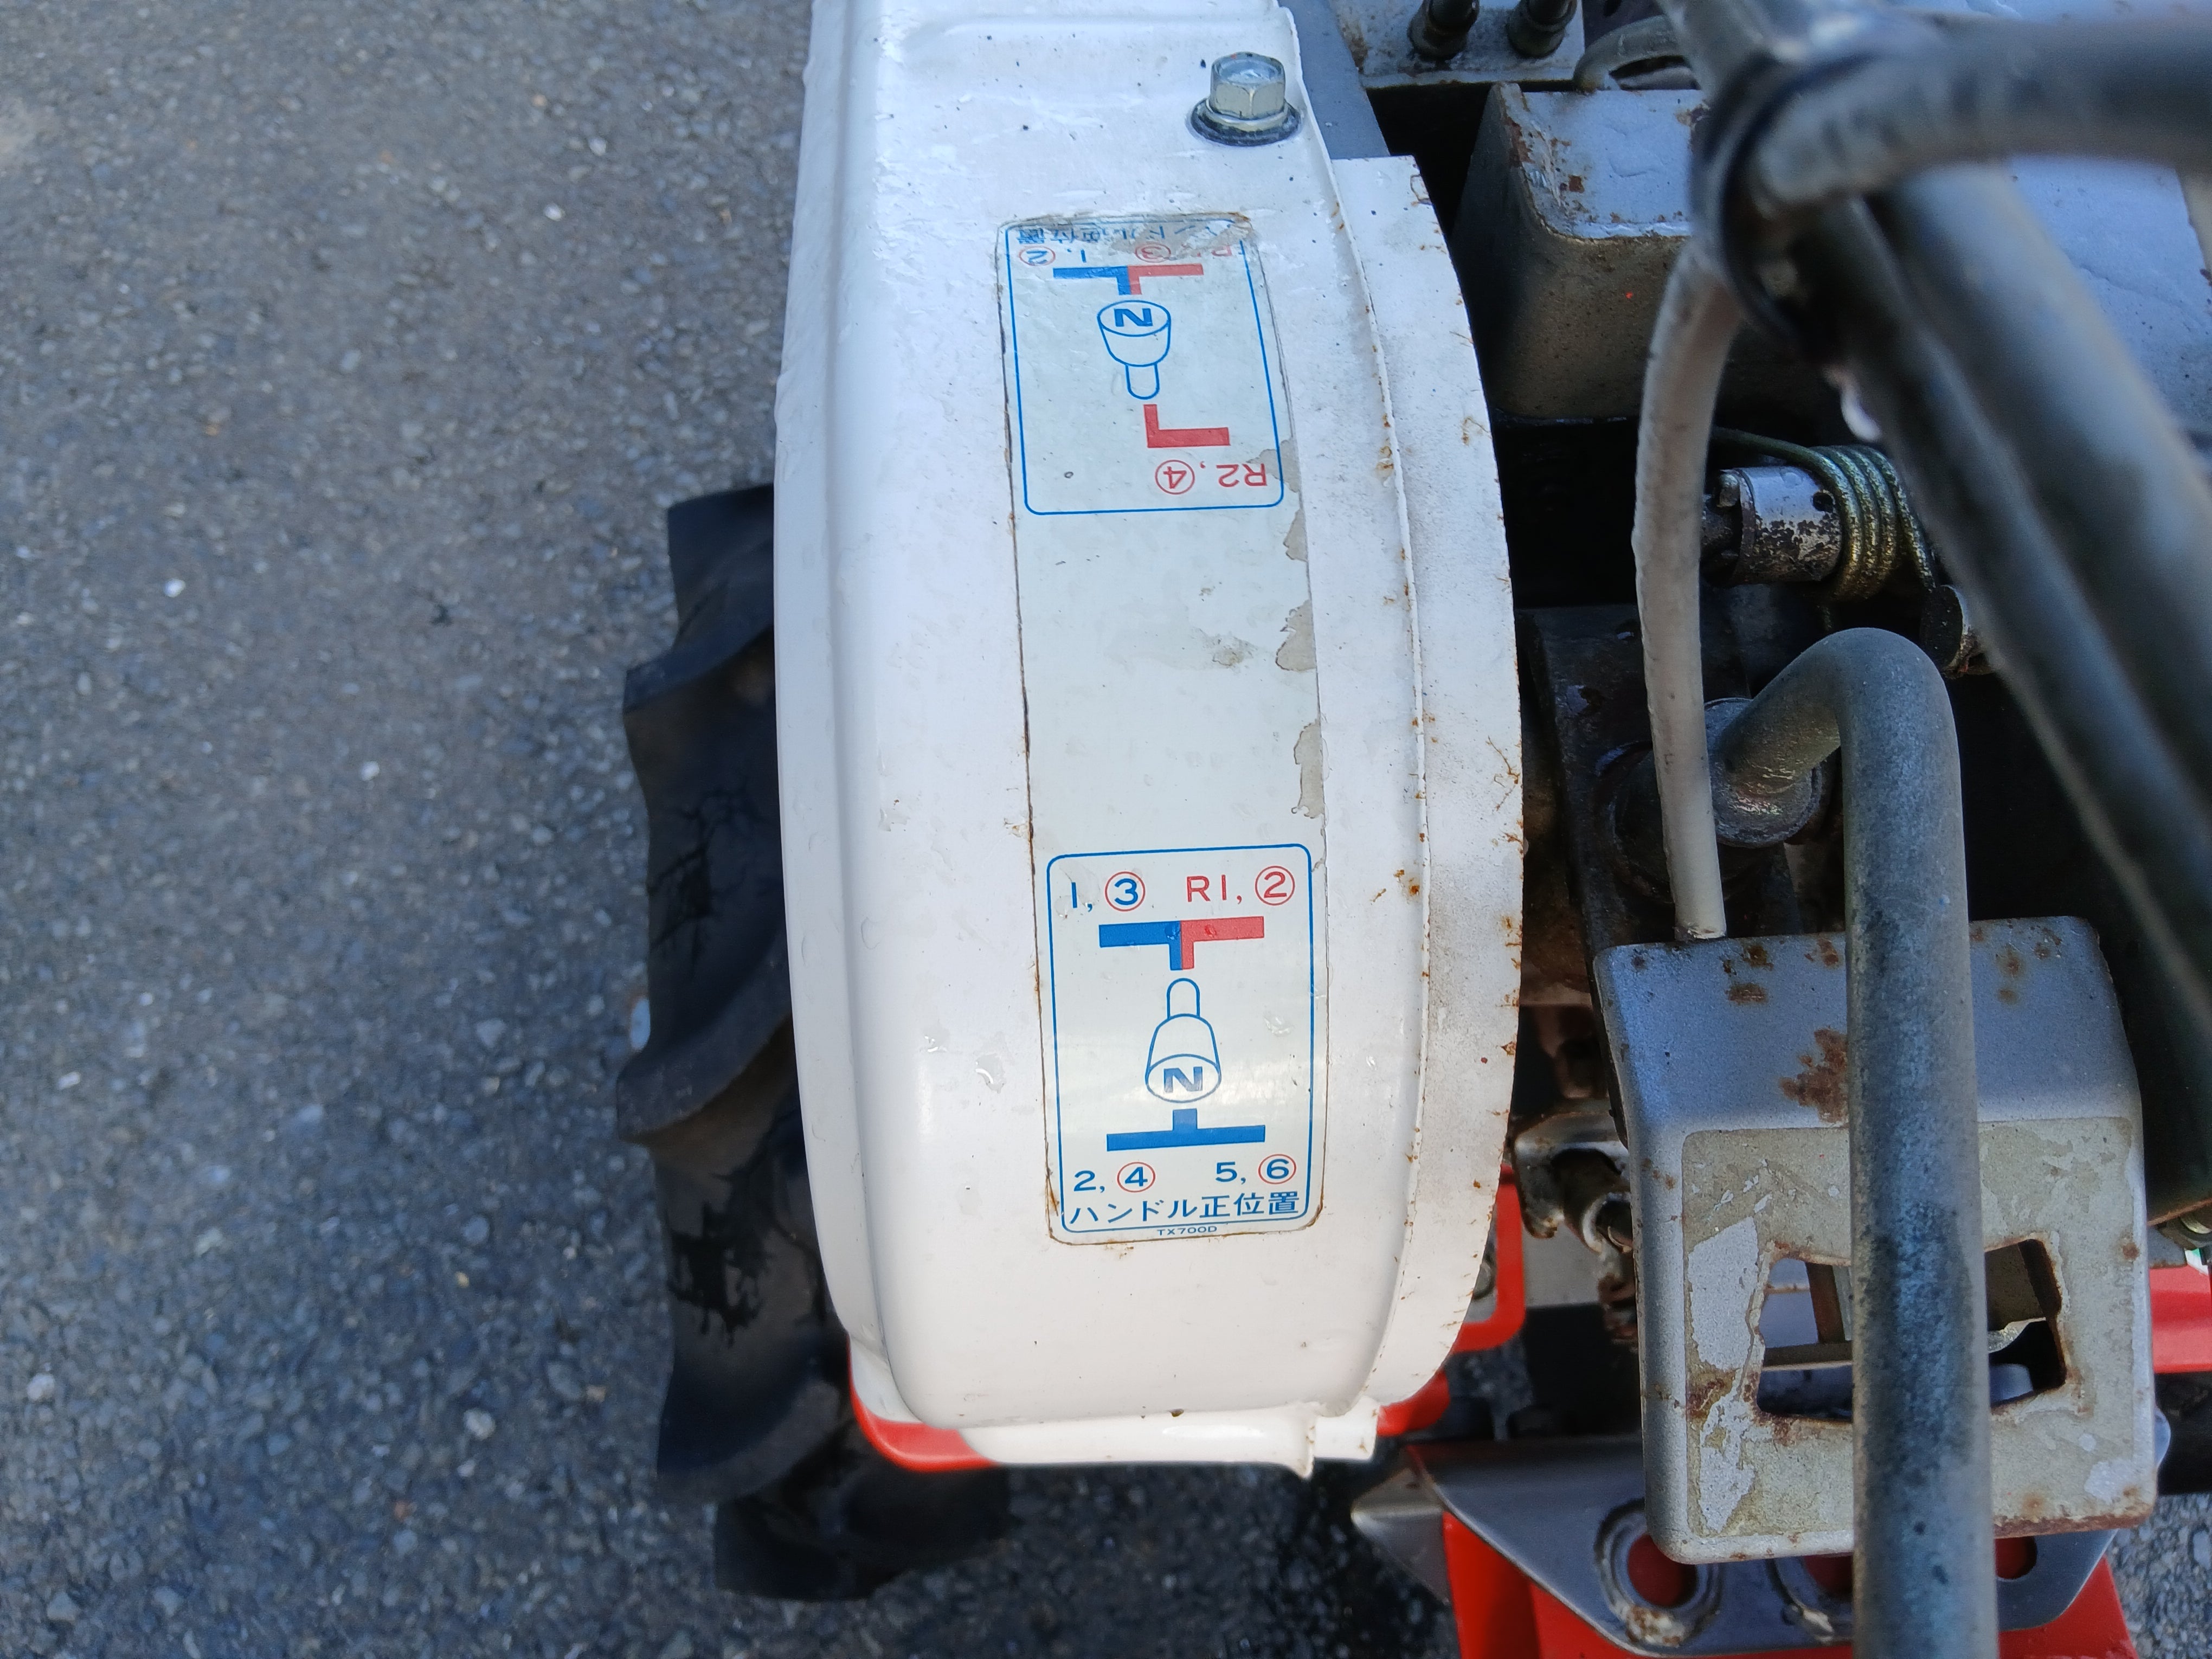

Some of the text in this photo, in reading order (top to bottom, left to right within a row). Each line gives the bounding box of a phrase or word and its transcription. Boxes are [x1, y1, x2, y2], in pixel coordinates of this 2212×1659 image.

[1114, 308, 1153, 327] N
[1163, 1066, 1203, 1092] N
[1070, 1191, 1300, 1224] ハンドル正位置
[1157, 1225, 1218, 1236] TX700D
